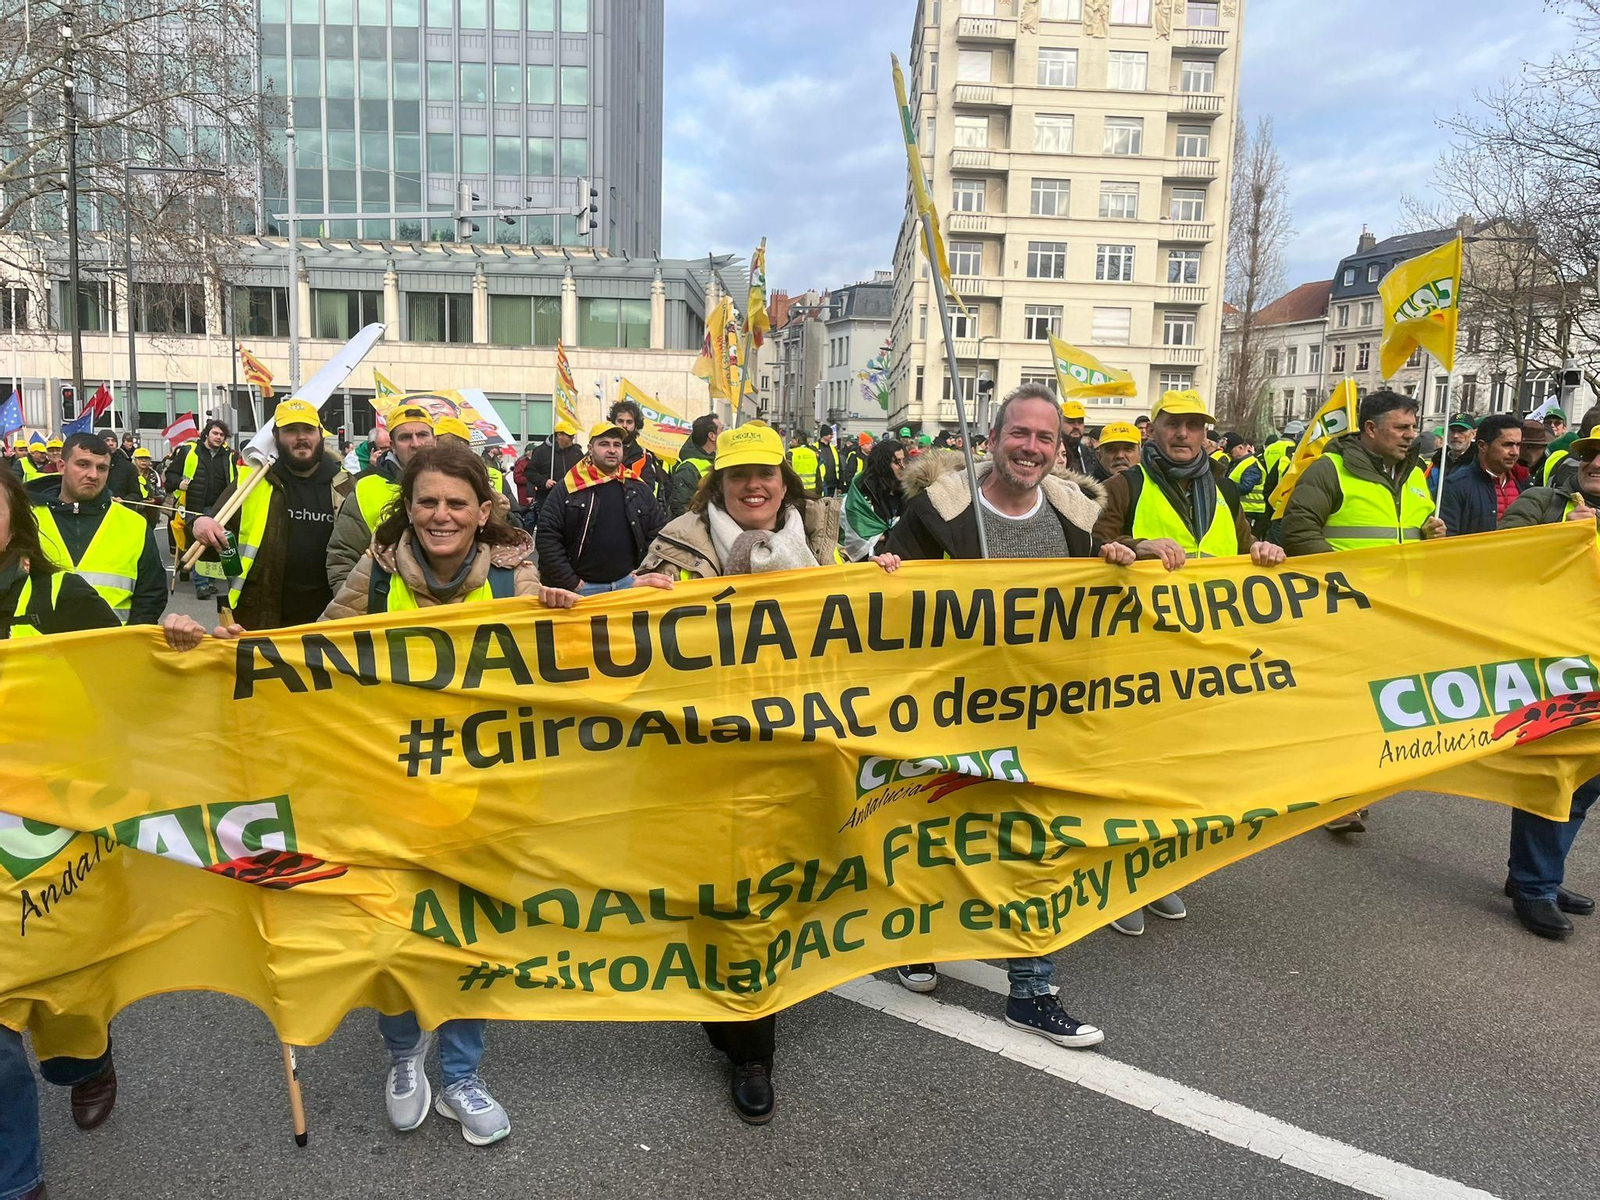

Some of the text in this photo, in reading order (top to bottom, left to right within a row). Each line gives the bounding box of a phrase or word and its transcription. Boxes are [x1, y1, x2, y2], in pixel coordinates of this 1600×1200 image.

[1057, 358, 1114, 386] COA
[233, 571, 1372, 700] ANDALUCÍA ALIMENTA EUROPA
[1379, 657, 1594, 727] COAG
[398, 648, 1296, 778] #GiroAlaPAC o despensa vacía
[859, 749, 1024, 790] COAG
[410, 854, 868, 949] ANDALUSIA
[884, 811, 1083, 887] FEEDS
[456, 908, 868, 995] #GiroAlaPAC
[881, 899, 944, 936] or
[958, 858, 1113, 937] empty
